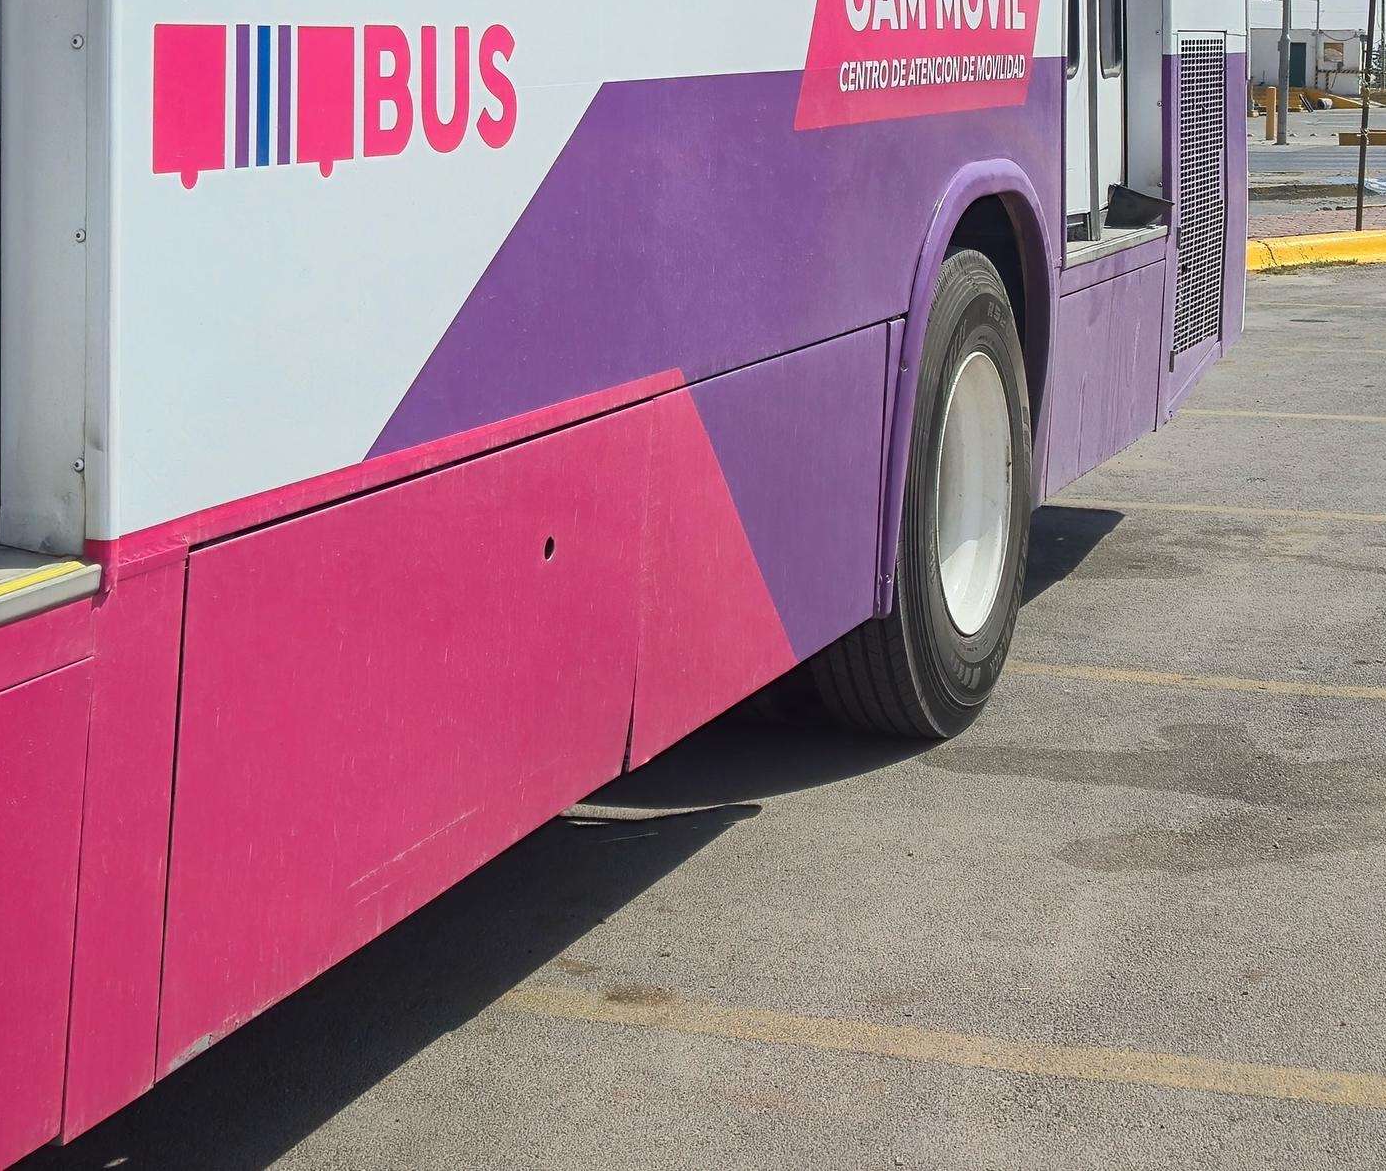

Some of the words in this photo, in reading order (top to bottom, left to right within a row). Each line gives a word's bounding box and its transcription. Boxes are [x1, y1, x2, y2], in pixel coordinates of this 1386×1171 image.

[364, 24, 517, 157] BUS
[839, 59, 889, 92] CENTRO
[890, 59, 906, 89] DE
[907, 56, 960, 87] ATENCION
[962, 56, 976, 82] DE
[976, 54, 1026, 81] MOVILIDAD
